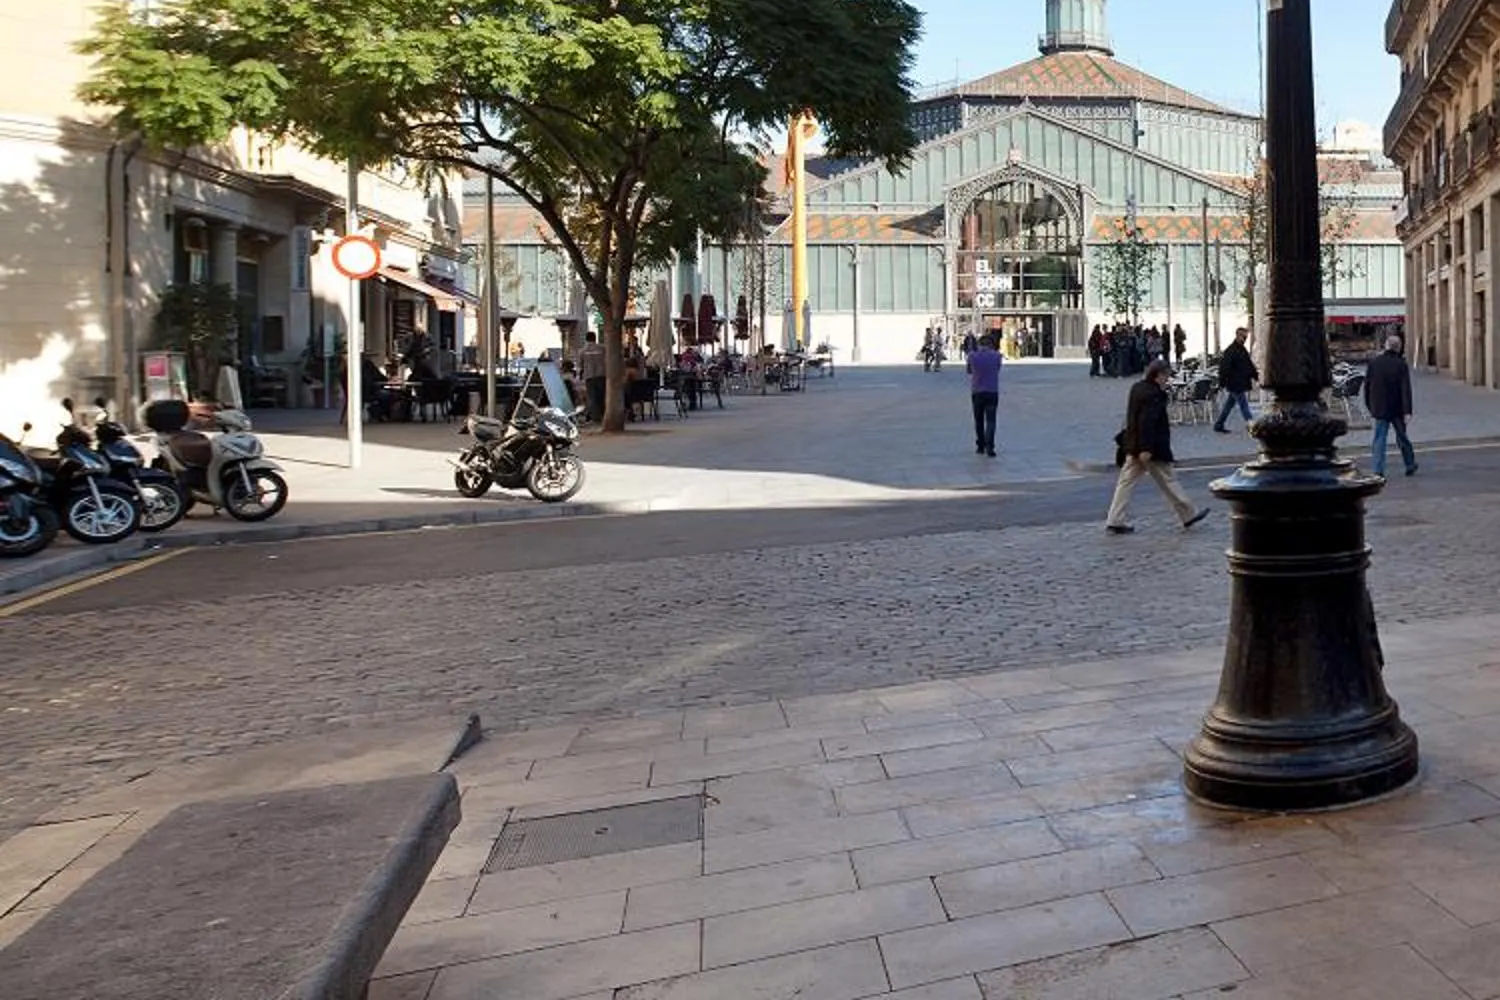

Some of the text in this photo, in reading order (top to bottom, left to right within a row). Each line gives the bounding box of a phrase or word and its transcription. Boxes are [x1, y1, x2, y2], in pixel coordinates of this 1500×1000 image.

[976, 259, 992, 273] EL
[976, 275, 1012, 291] BORN
[976, 292, 995, 307] CC
